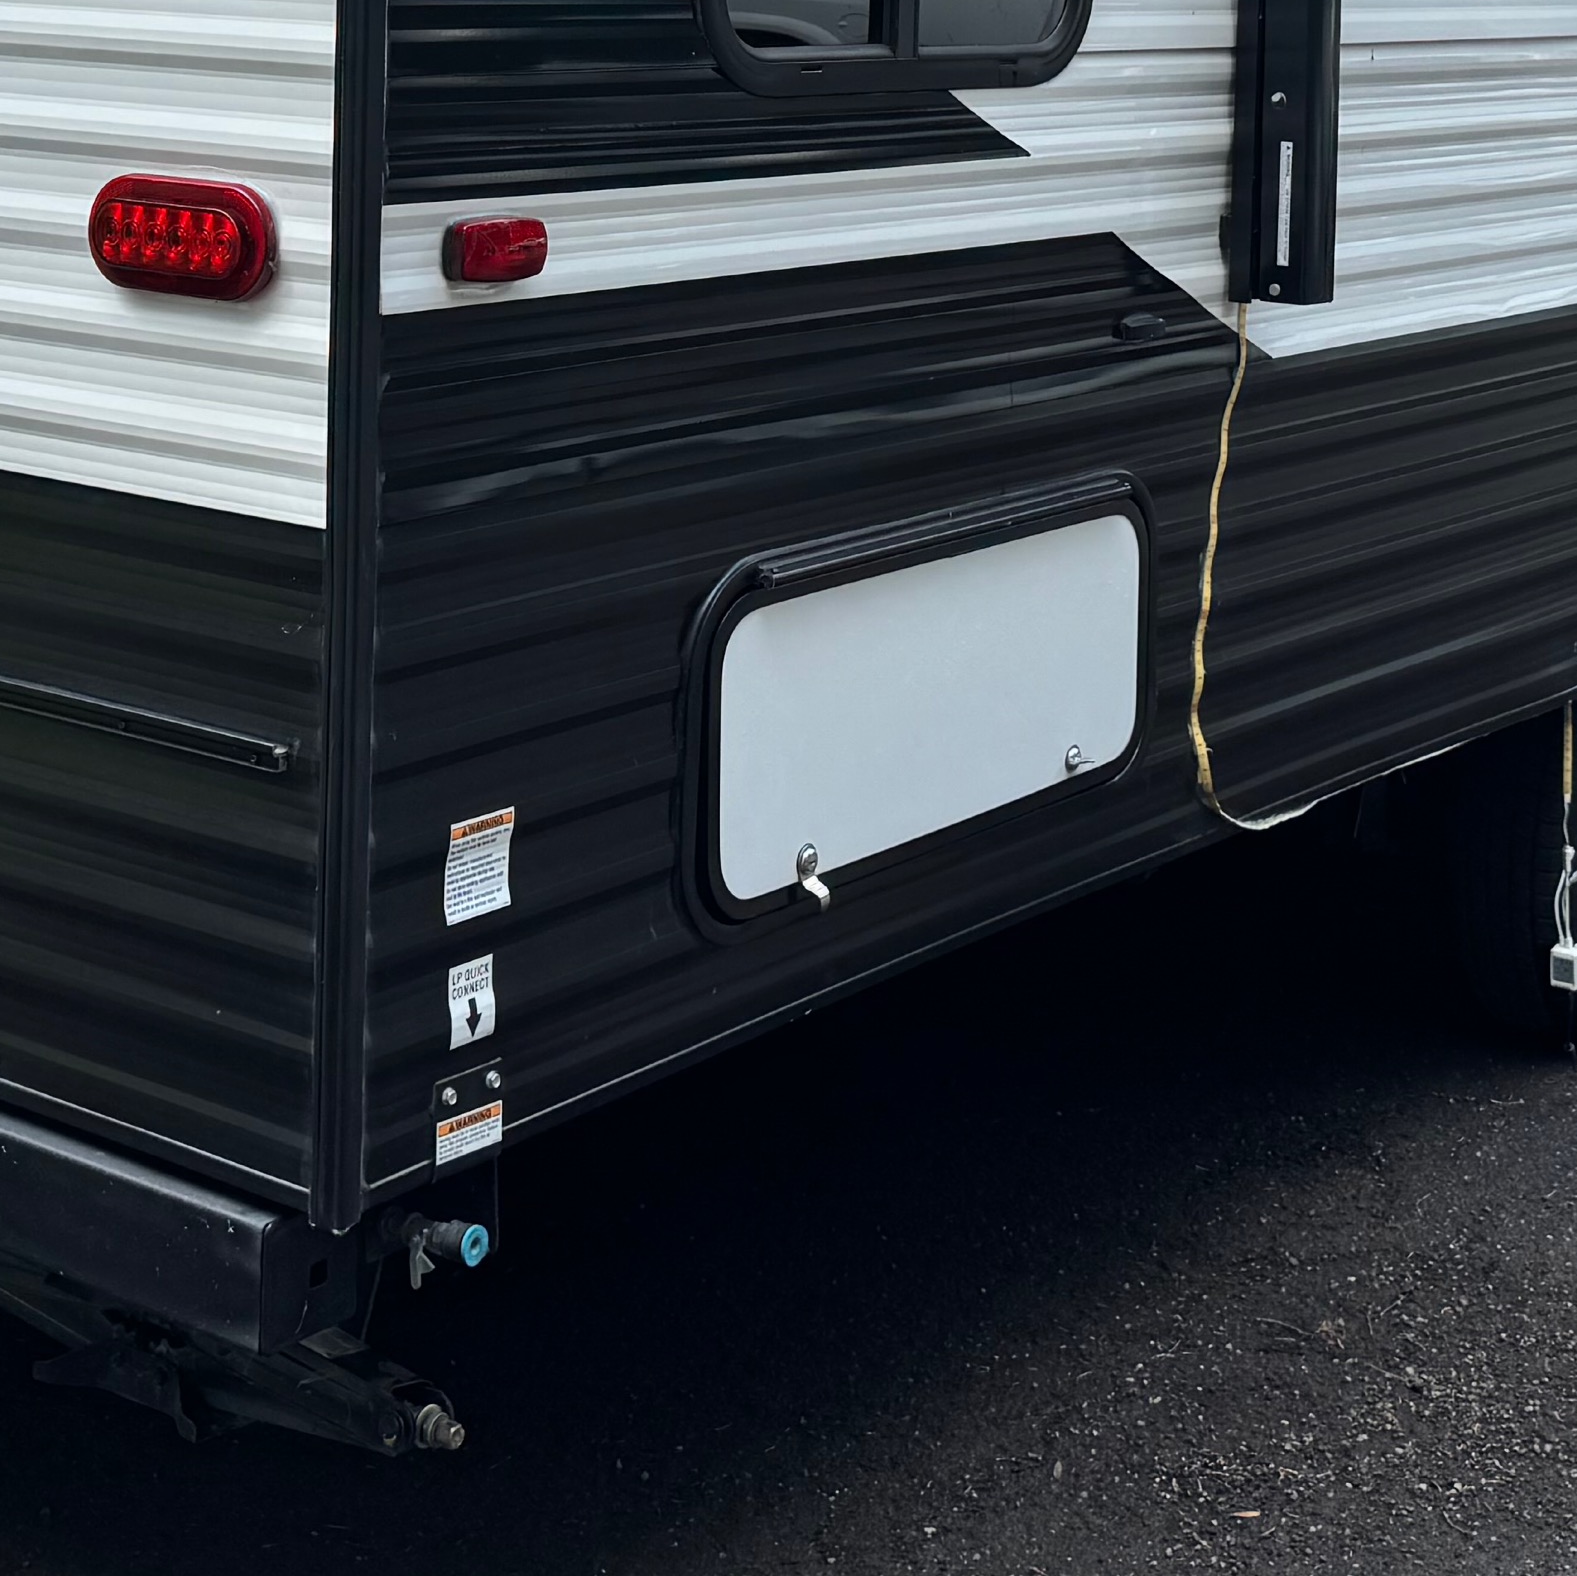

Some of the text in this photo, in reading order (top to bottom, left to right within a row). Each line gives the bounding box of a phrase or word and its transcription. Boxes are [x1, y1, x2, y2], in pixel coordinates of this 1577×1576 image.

[452, 962, 490, 986] LP QUICK
[452, 977, 489, 1000] CONNECT
